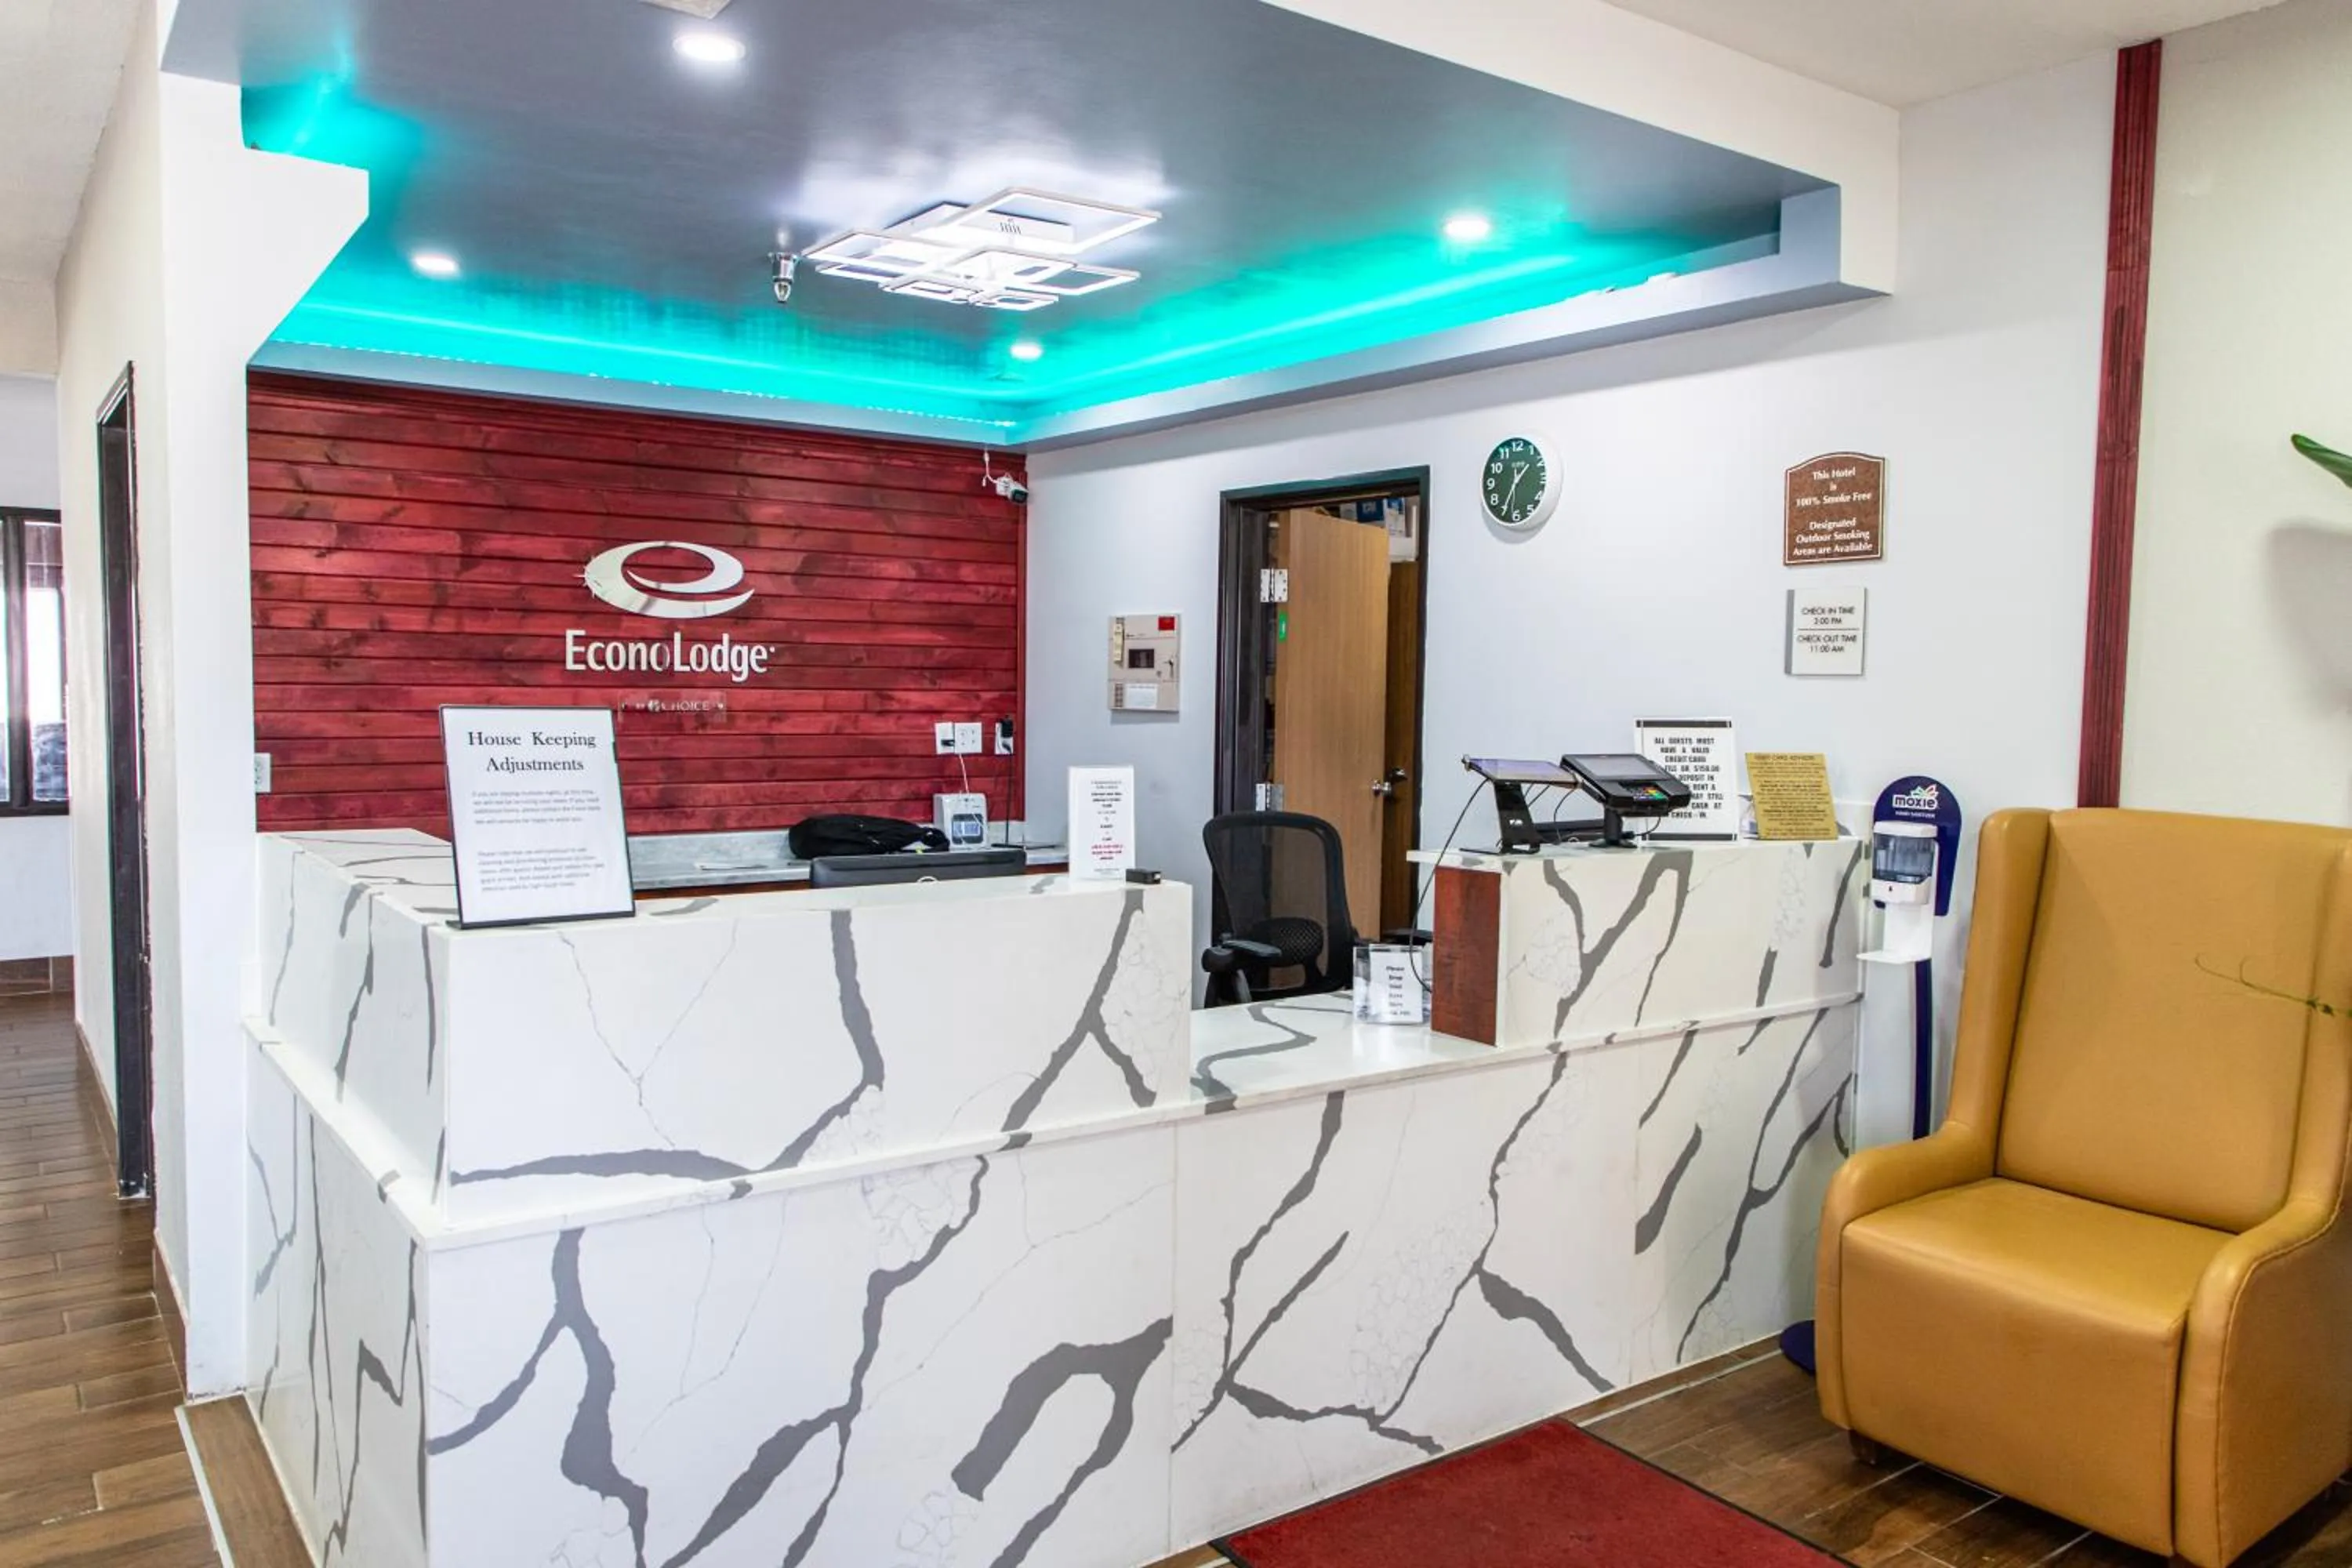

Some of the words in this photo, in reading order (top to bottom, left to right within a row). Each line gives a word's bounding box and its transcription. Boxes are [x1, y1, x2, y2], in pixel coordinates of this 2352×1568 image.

[1499, 446, 1509, 459] 11
[1512, 441, 1523, 452] 12
[1529, 445, 1534, 455] 1
[1537, 456, 1544, 466] 2
[1491, 463, 1502, 474] 10
[1813, 470, 1829, 480] This
[1831, 466, 1856, 477] Hotel
[1486, 477, 1494, 489] 9
[1490, 493, 1498, 505] 8
[1796, 496, 1820, 507] 100%
[1823, 493, 1850, 503] Smoke
[1853, 492, 1872, 501] Free
[1526, 504, 1534, 514] 5
[1512, 510, 1520, 521] 6
[1809, 517, 1856, 530] Designated
[1796, 533, 1831, 543] Outdoor
[1834, 530, 1870, 540] Smoking
[1793, 546, 1816, 556] Areas
[1835, 543, 1873, 553] Available
[1802, 607, 1825, 615] CHECK
[565, 630, 768, 682] EconoLodge
[468, 731, 521, 746] House
[532, 731, 597, 748] Keeping
[486, 757, 584, 773] Adjustments
[1895, 797, 1935, 808] moxie
